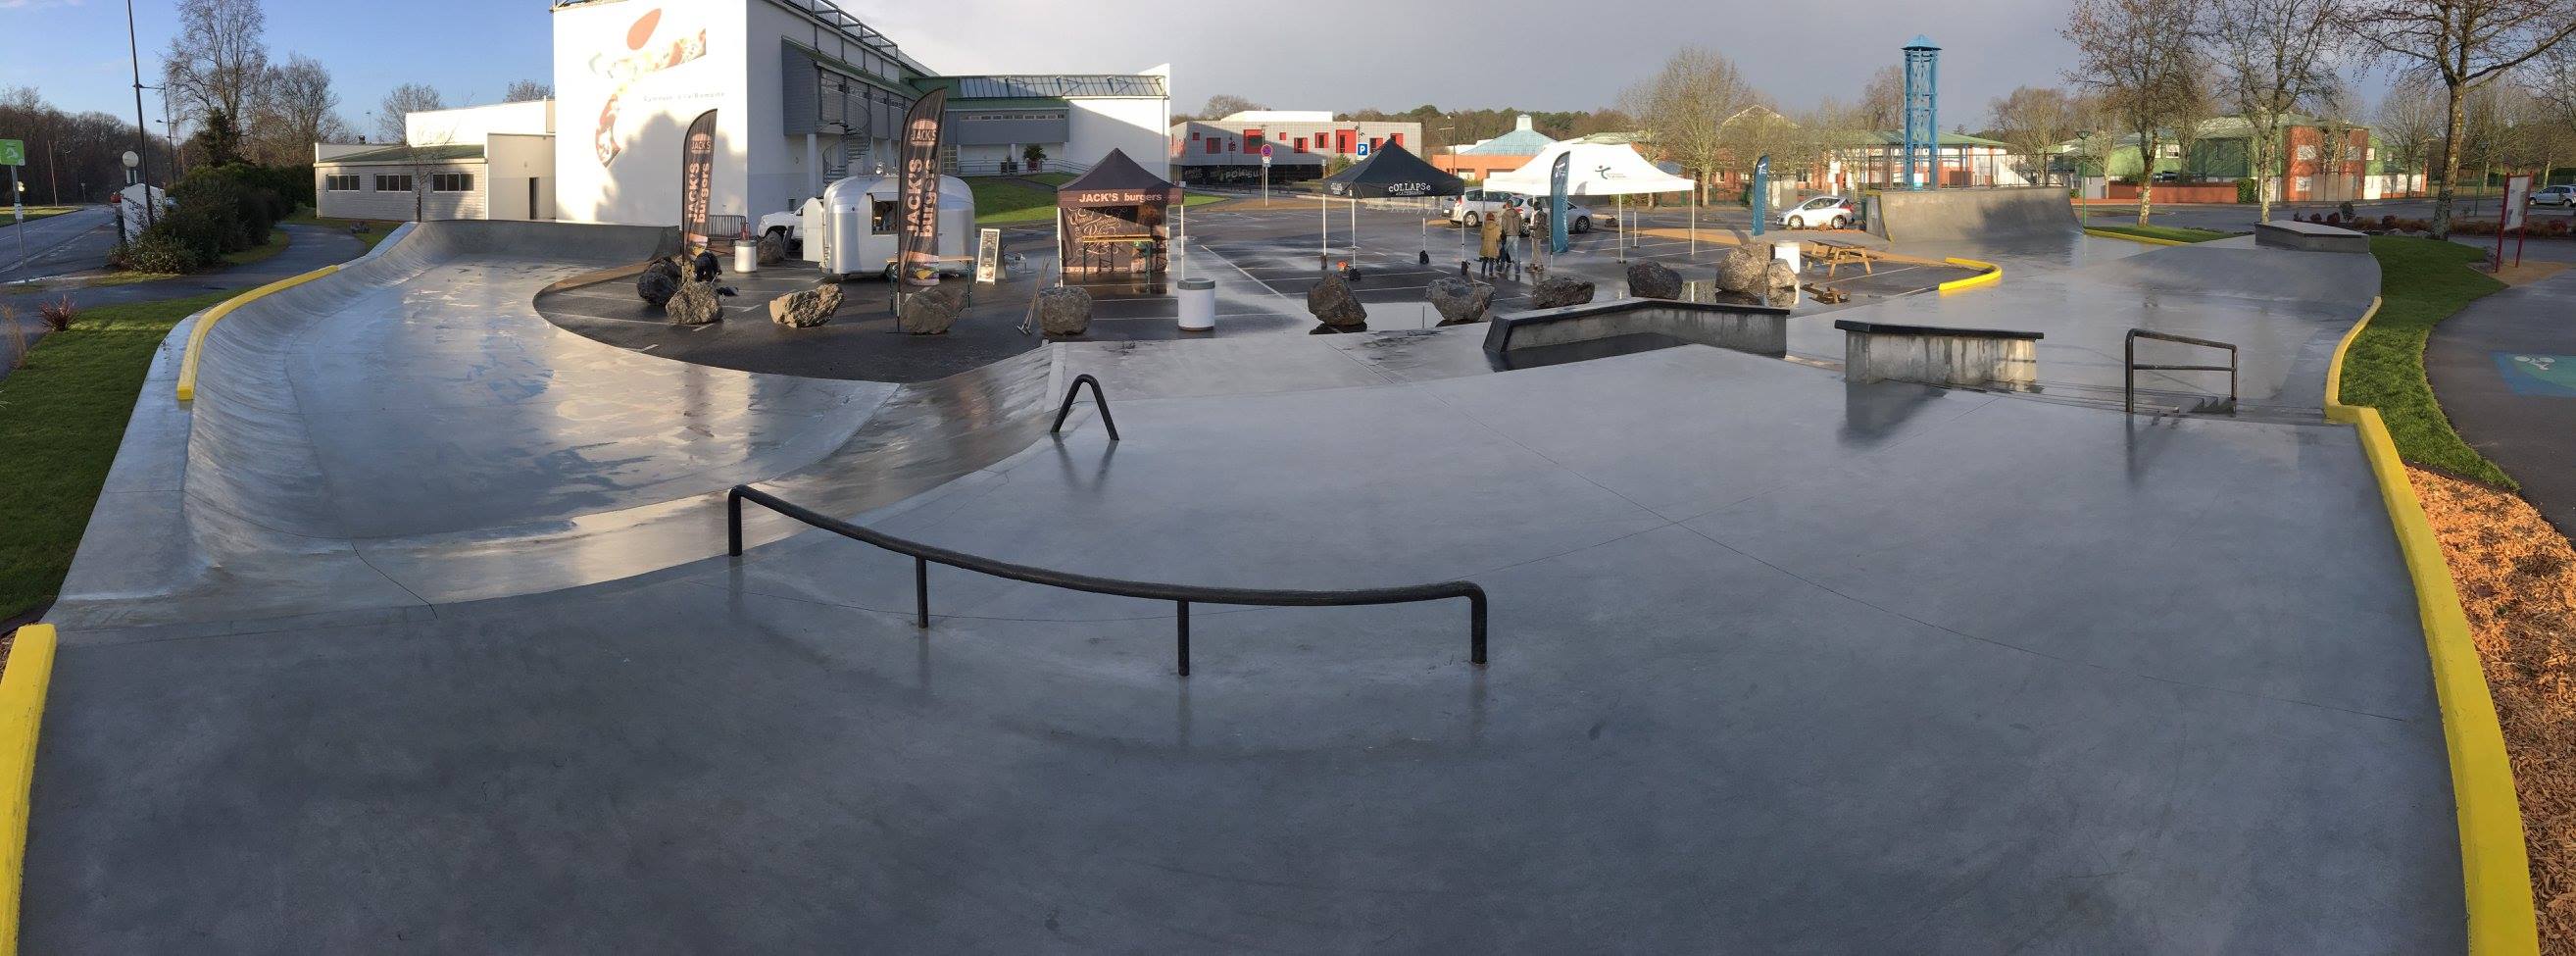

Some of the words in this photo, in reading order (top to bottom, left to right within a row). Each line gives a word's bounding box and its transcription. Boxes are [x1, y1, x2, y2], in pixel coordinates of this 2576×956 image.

[688, 162, 700, 224] JACK'S
[907, 158, 923, 237] JACK'S
[1078, 192, 1119, 203] JACK'S
[1123, 192, 1163, 203] burgers
